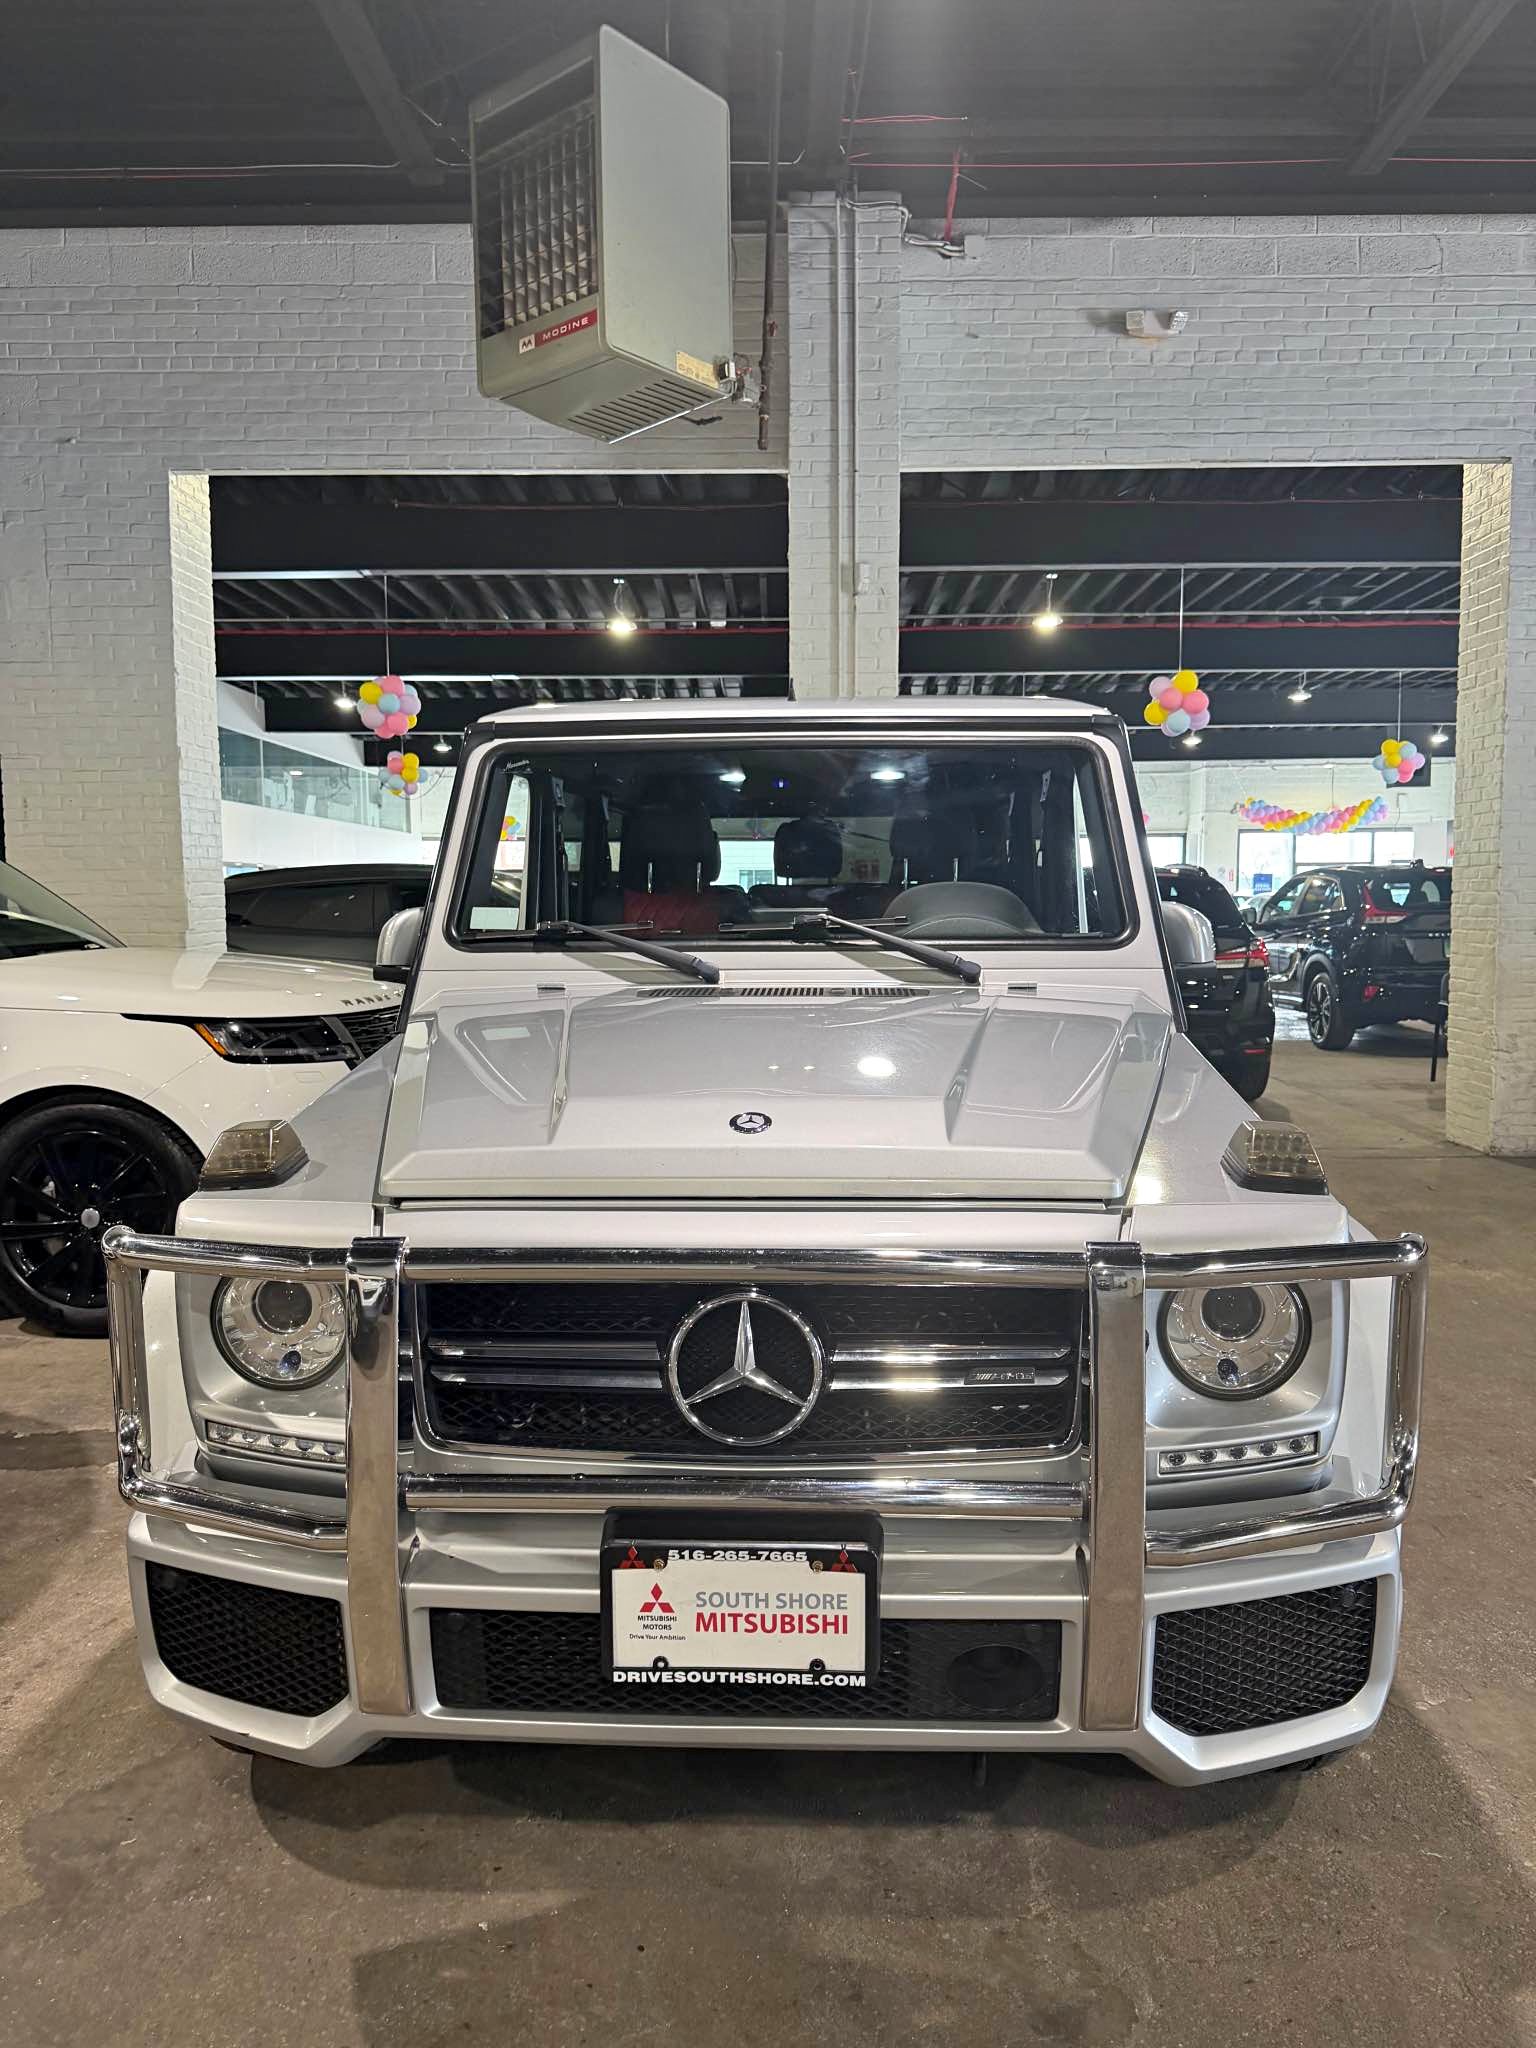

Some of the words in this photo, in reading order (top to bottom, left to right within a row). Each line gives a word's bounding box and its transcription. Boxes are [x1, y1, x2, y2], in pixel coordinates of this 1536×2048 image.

[542, 317, 589, 341] MODINE
[668, 1549, 807, 1562] 516-265-7665
[695, 1591, 769, 1609] SOUTH
[775, 1592, 848, 1610] SHORE
[642, 1623, 672, 1631] MOTORS
[695, 1611, 848, 1634] MITSUBISHI
[613, 1671, 866, 1687] DRIVESOUTHSHORE.COM
